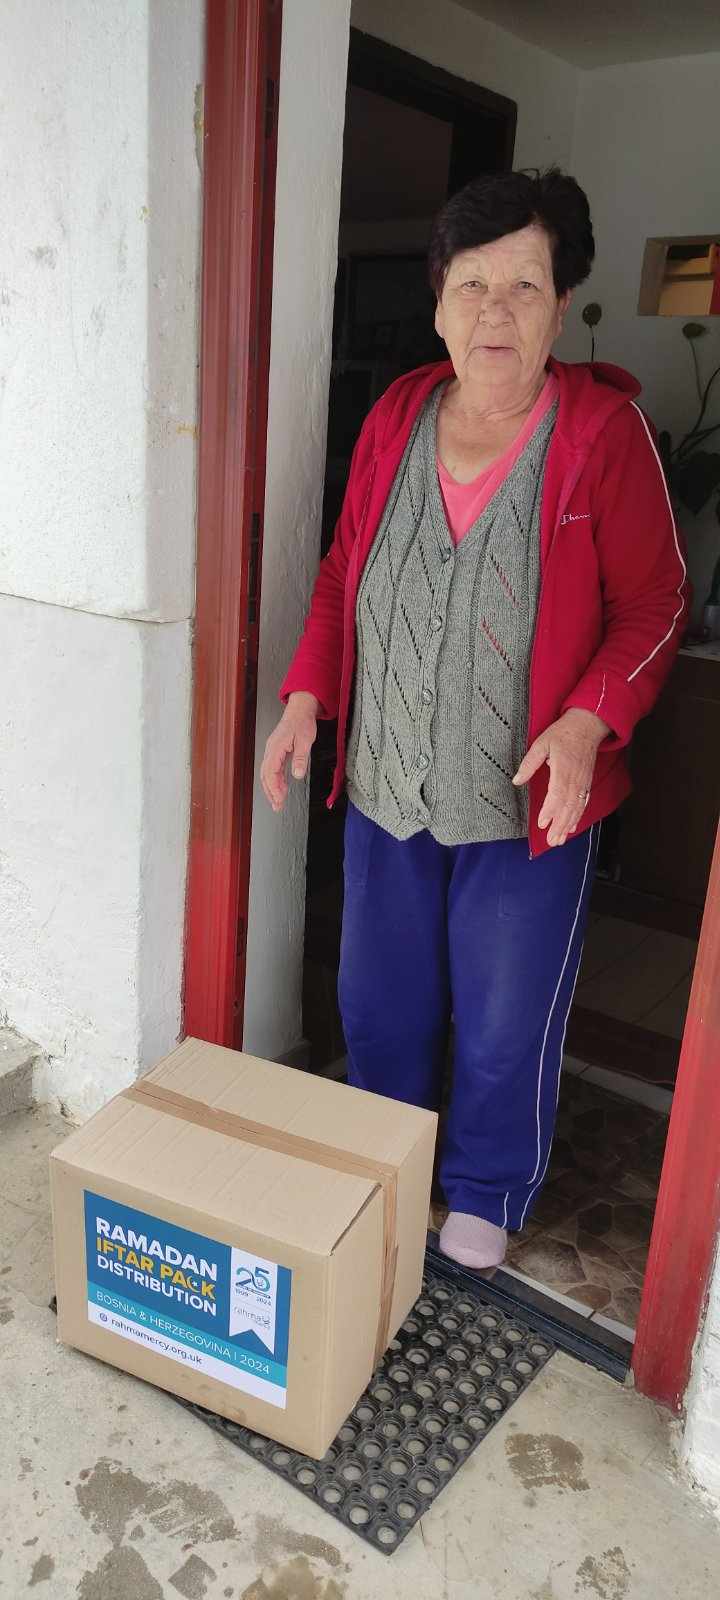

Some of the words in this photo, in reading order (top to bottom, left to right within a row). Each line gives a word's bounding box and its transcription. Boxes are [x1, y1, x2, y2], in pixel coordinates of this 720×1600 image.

[96, 1217, 217, 1281] RAMADAN
[97, 1238, 154, 1274] IFTAR
[160, 1264, 216, 1300] PACK
[236, 1266, 270, 1292] 25
[97, 1255, 216, 1316] DISTRIBUTION
[96, 1290, 137, 1317] BOSNIA
[140, 1311, 148, 1322] &
[150, 1316, 231, 1359] HERZEGOVINA
[240, 1354, 270, 1374] 2024
[112, 1318, 203, 1364] rahmamercy.org.uk
